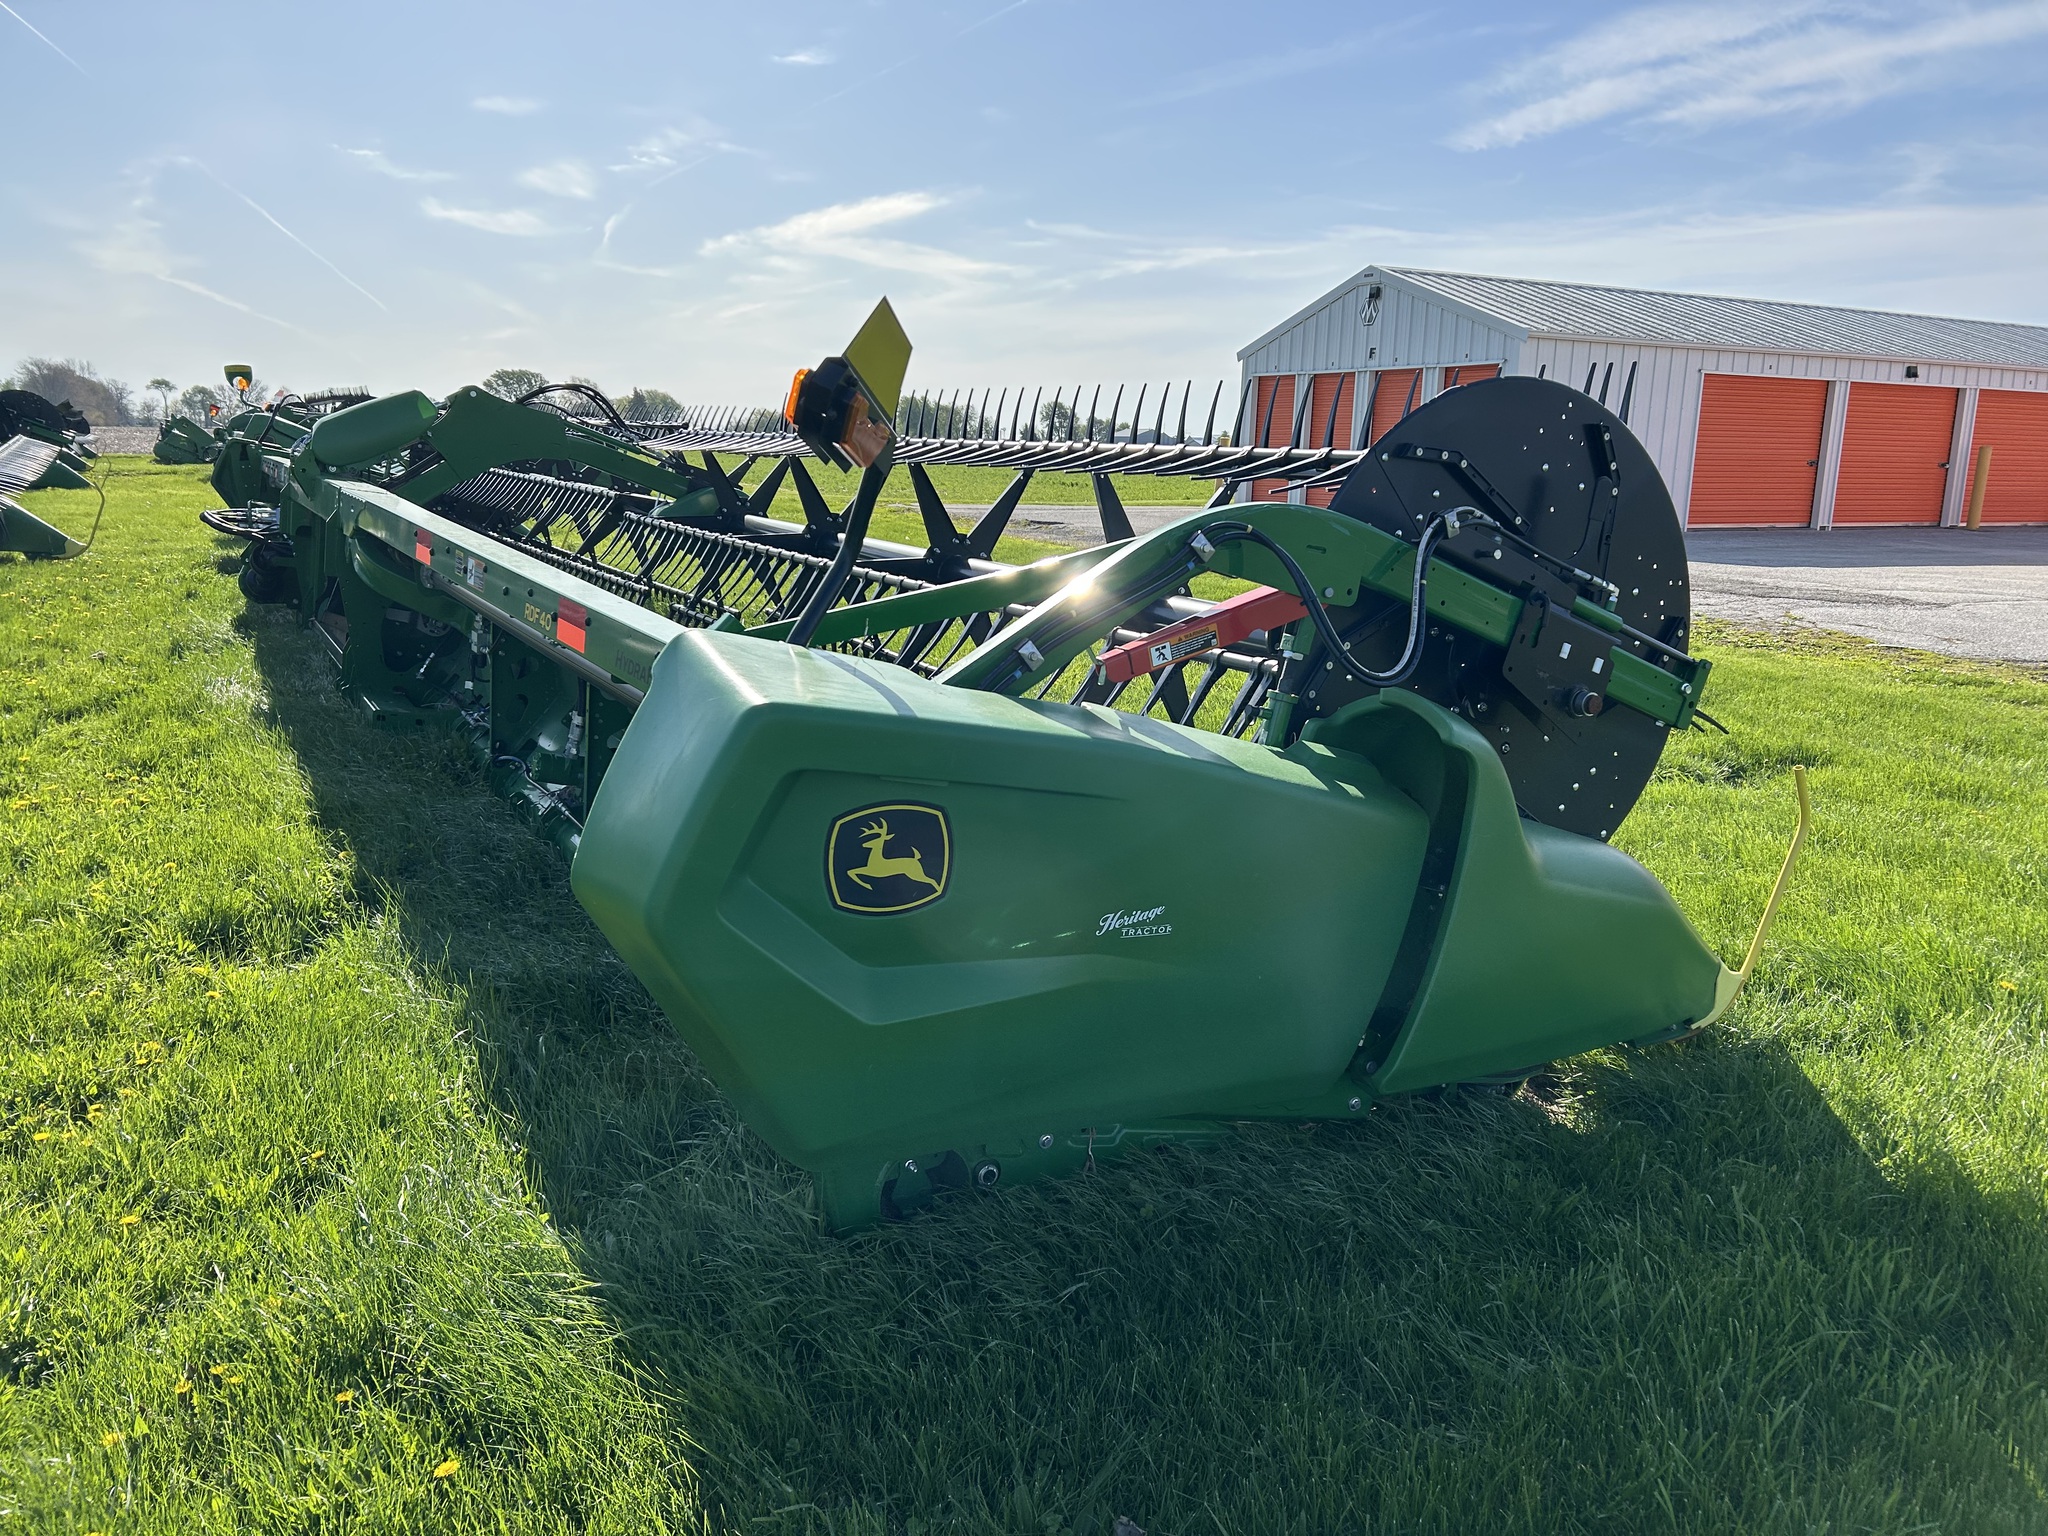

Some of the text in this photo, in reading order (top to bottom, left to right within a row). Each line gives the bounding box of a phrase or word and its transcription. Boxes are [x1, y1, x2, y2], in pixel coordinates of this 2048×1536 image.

[1369, 347, 1377, 359] F
[524, 603, 552, 631] RDF 40
[1095, 905, 1165, 936] Heritage
[1121, 925, 1172, 937] TRACTOR
